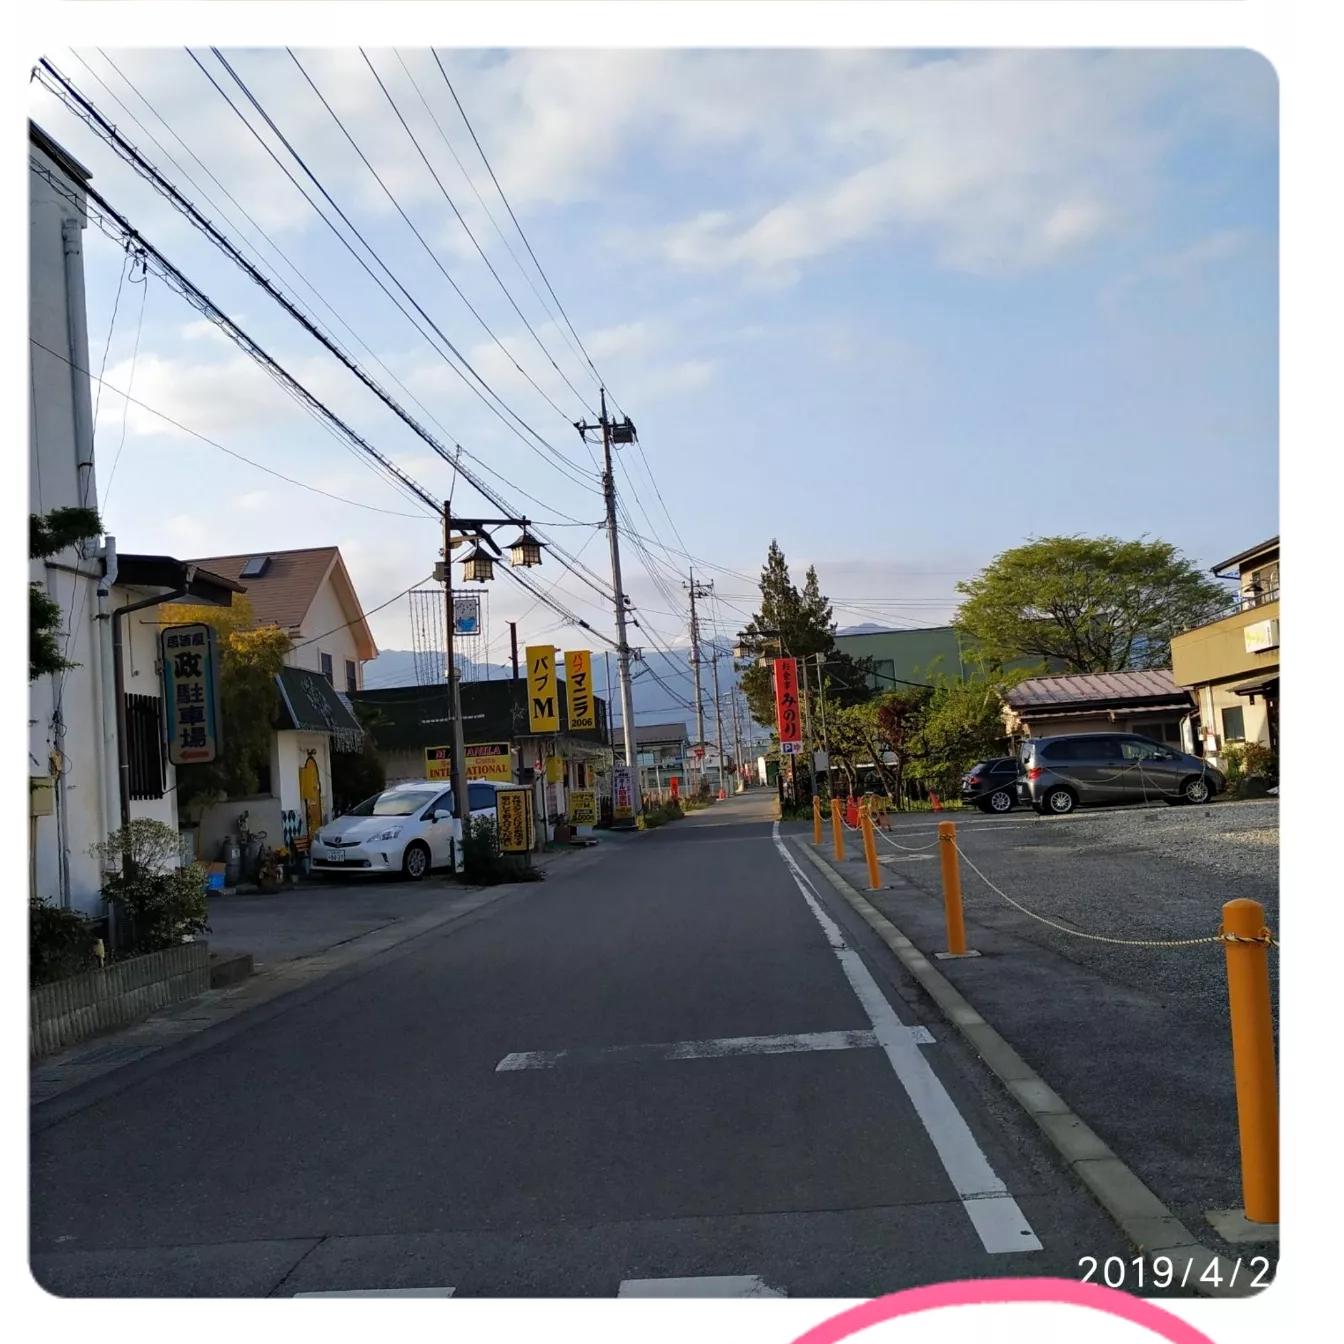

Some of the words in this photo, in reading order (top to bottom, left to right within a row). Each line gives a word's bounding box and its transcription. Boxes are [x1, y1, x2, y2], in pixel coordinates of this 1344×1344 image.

[571, 672, 588, 718] マニラ
[177, 682, 207, 748] 駐車場
[533, 696, 555, 719] M
[571, 718, 593, 727] 2006
[429, 763, 508, 778] INTATIONAL
